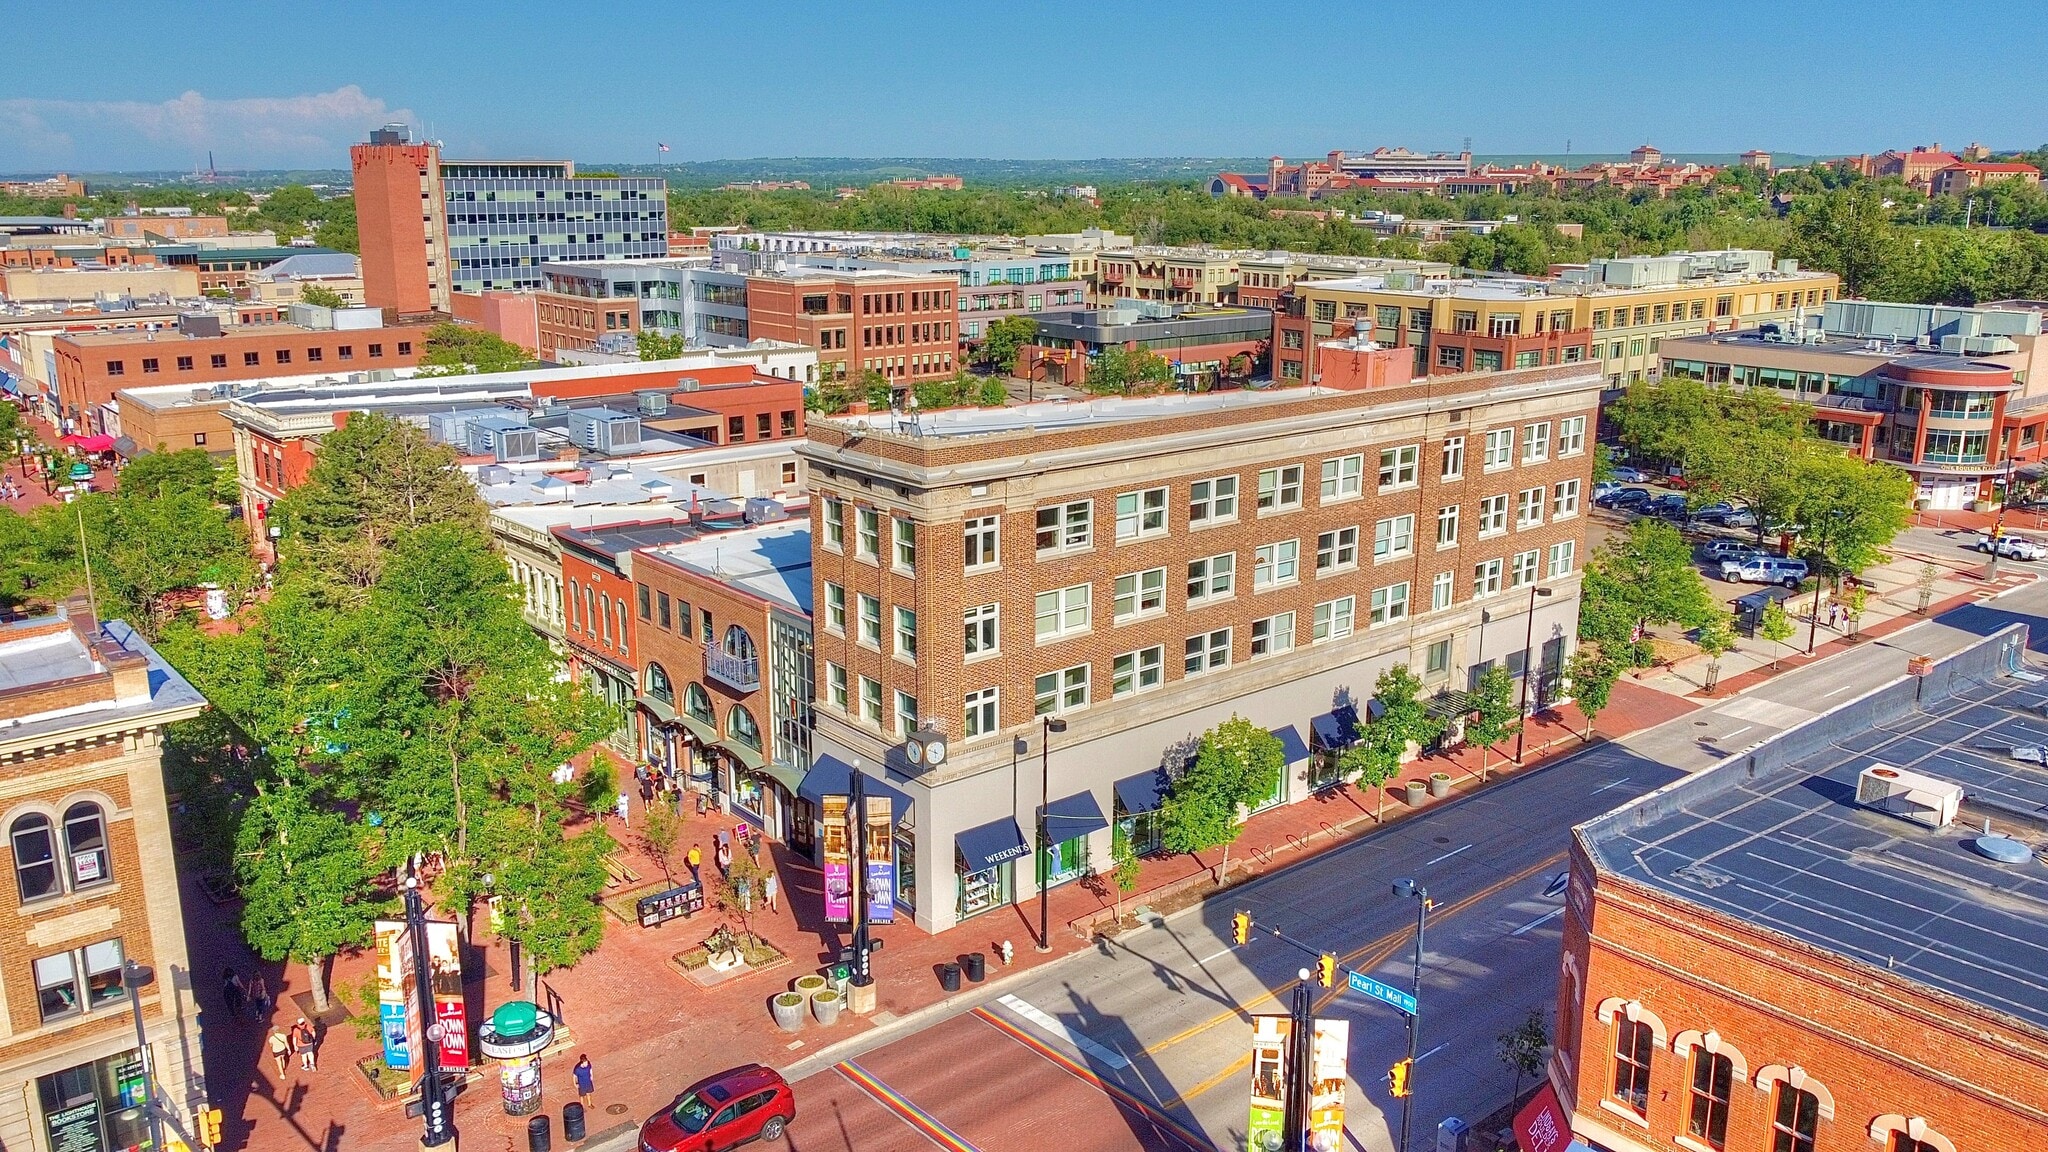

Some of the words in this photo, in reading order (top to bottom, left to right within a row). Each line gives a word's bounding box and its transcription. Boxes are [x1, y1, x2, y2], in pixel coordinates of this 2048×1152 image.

[984, 843, 1030, 864] WEEKENDS
[1351, 975, 1373, 992] Pearl
[1374, 985, 1384, 997] St
[1386, 989, 1402, 1005] Mall
[48, 1113, 61, 1121] THE
[61, 1102, 97, 1118] LIGHTHOUSE
[51, 1108, 95, 1128] BOOKSTORE
